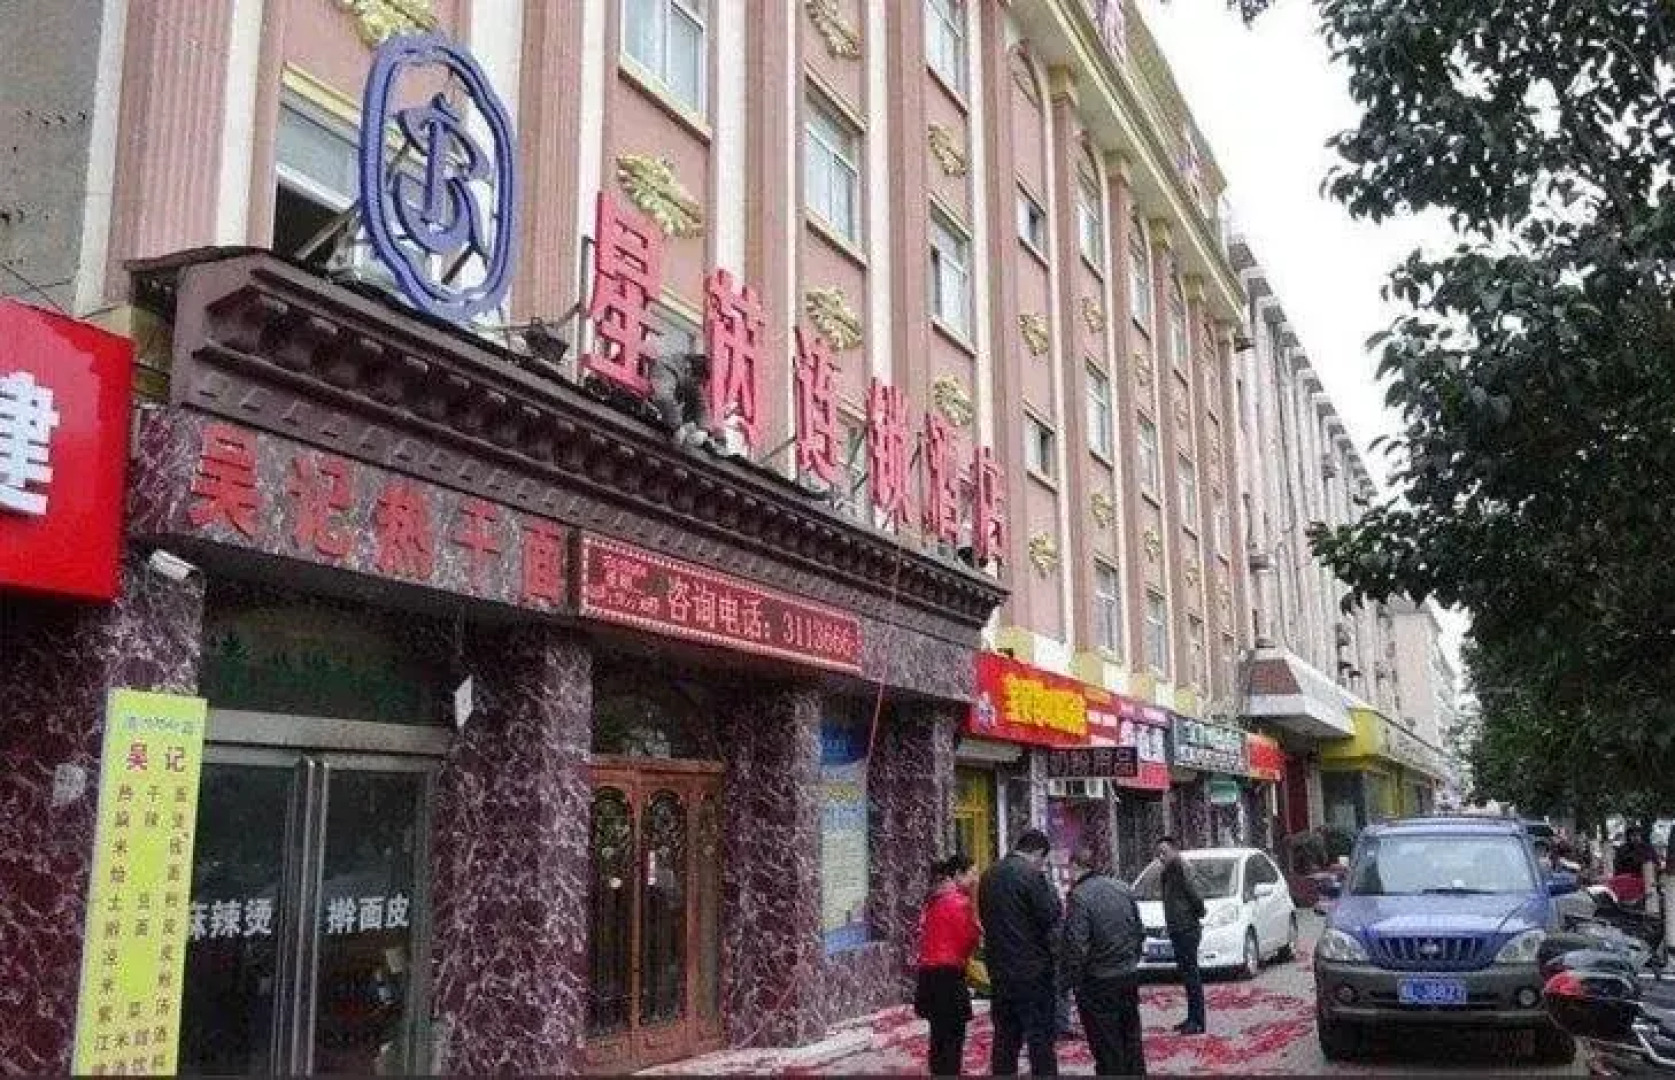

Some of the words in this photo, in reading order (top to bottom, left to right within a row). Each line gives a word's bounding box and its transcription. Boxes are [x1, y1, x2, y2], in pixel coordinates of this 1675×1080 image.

[189, 423, 566, 608] 吴记热干面
